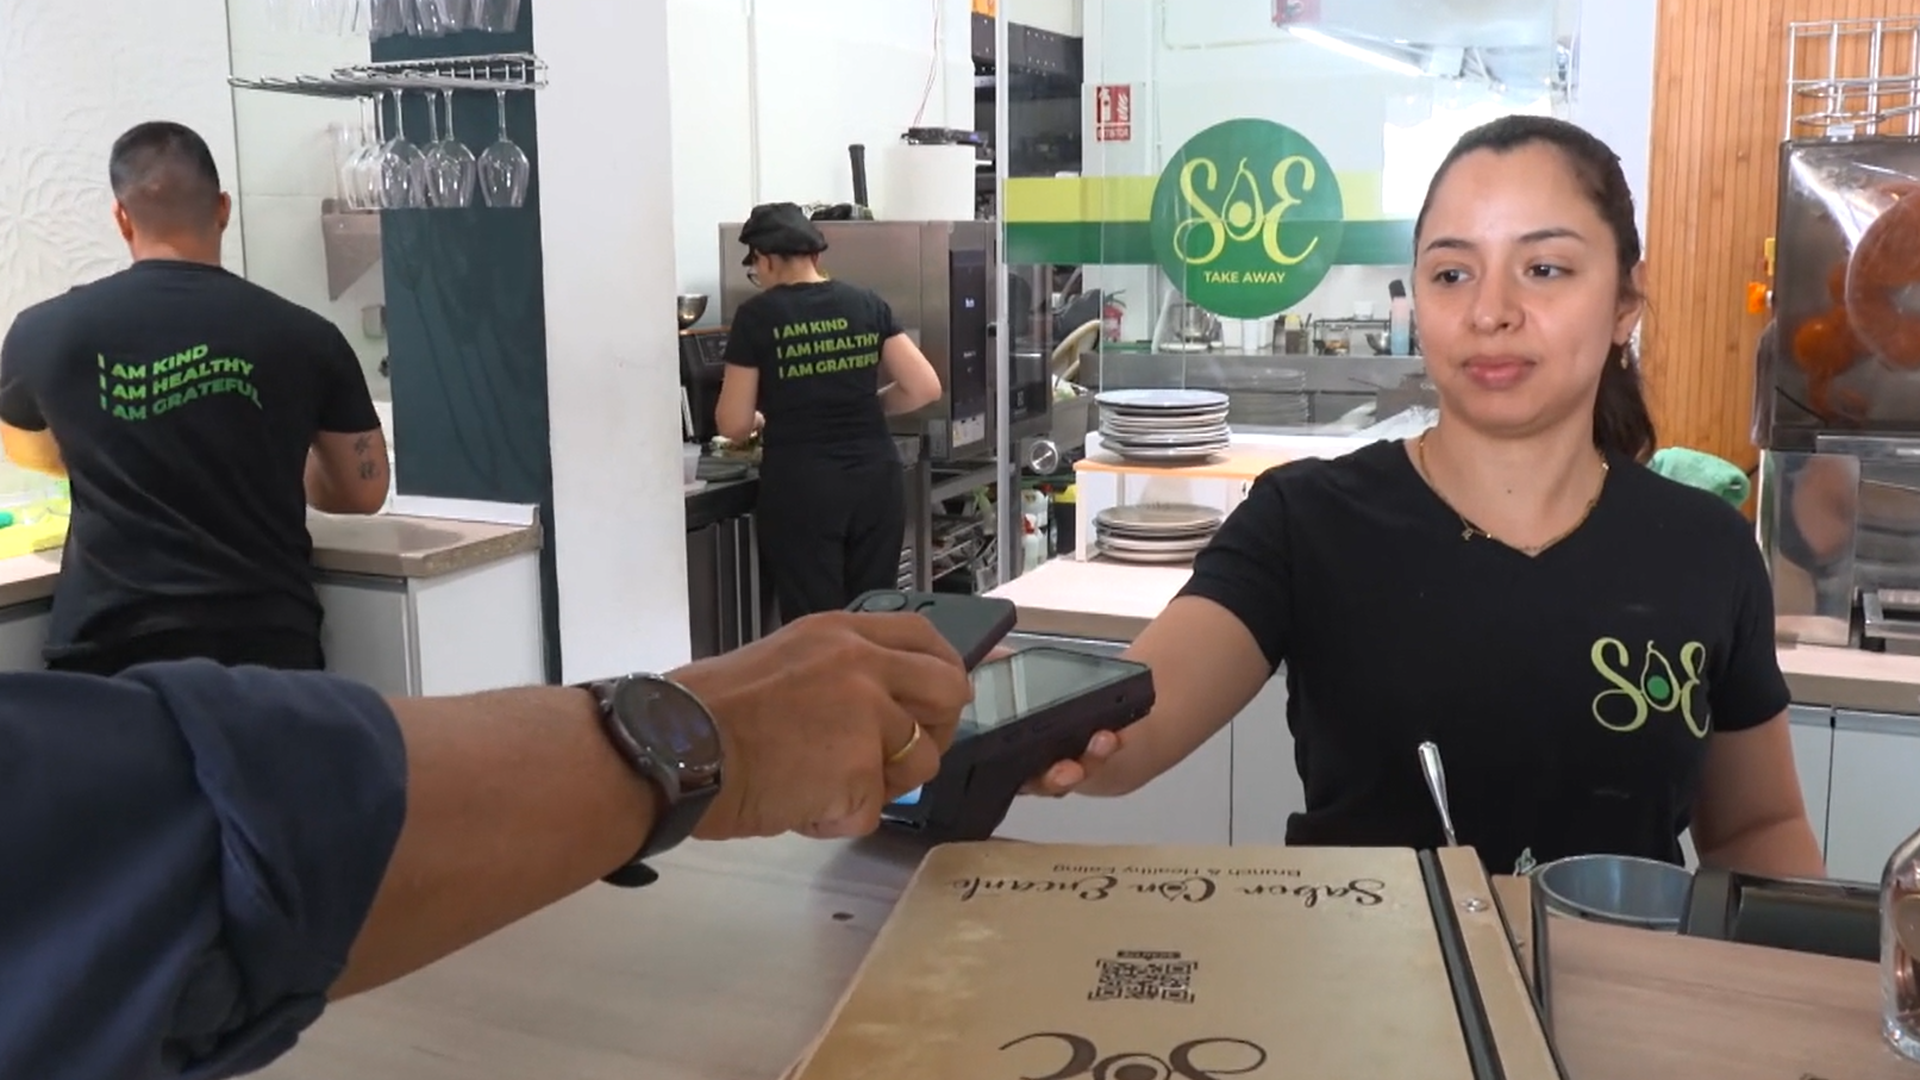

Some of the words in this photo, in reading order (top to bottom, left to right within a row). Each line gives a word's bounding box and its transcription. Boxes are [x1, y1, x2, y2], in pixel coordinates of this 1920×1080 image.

[1203, 271, 1239, 283] TAKE
[1242, 271, 1286, 283] AWAY
[773, 327, 780, 339] I
[783, 322, 808, 338] AM
[810, 318, 848, 333] KIND
[777, 346, 782, 359] I
[786, 342, 812, 358] AM
[814, 333, 879, 353] HEALTHY
[98, 353, 105, 369] I
[111, 363, 146, 379] AM
[153, 344, 209, 375] KIND
[779, 366, 784, 379] I
[787, 363, 813, 378] AM
[815, 352, 879, 373] GRATEFU
[100, 374, 106, 390] I
[112, 383, 146, 399] AM
[153, 358, 254, 395] HEALTHY
[101, 393, 107, 410] I
[113, 404, 146, 420] AM
[152, 378, 263, 416] GRATEFUL
[1053, 864, 1116, 874] Eating
[1123, 866, 1199, 876] Healthy
[1207, 867, 1221, 876] &
[1228, 868, 1301, 877] Brunch
[1240, 878, 1385, 908] Sabor
